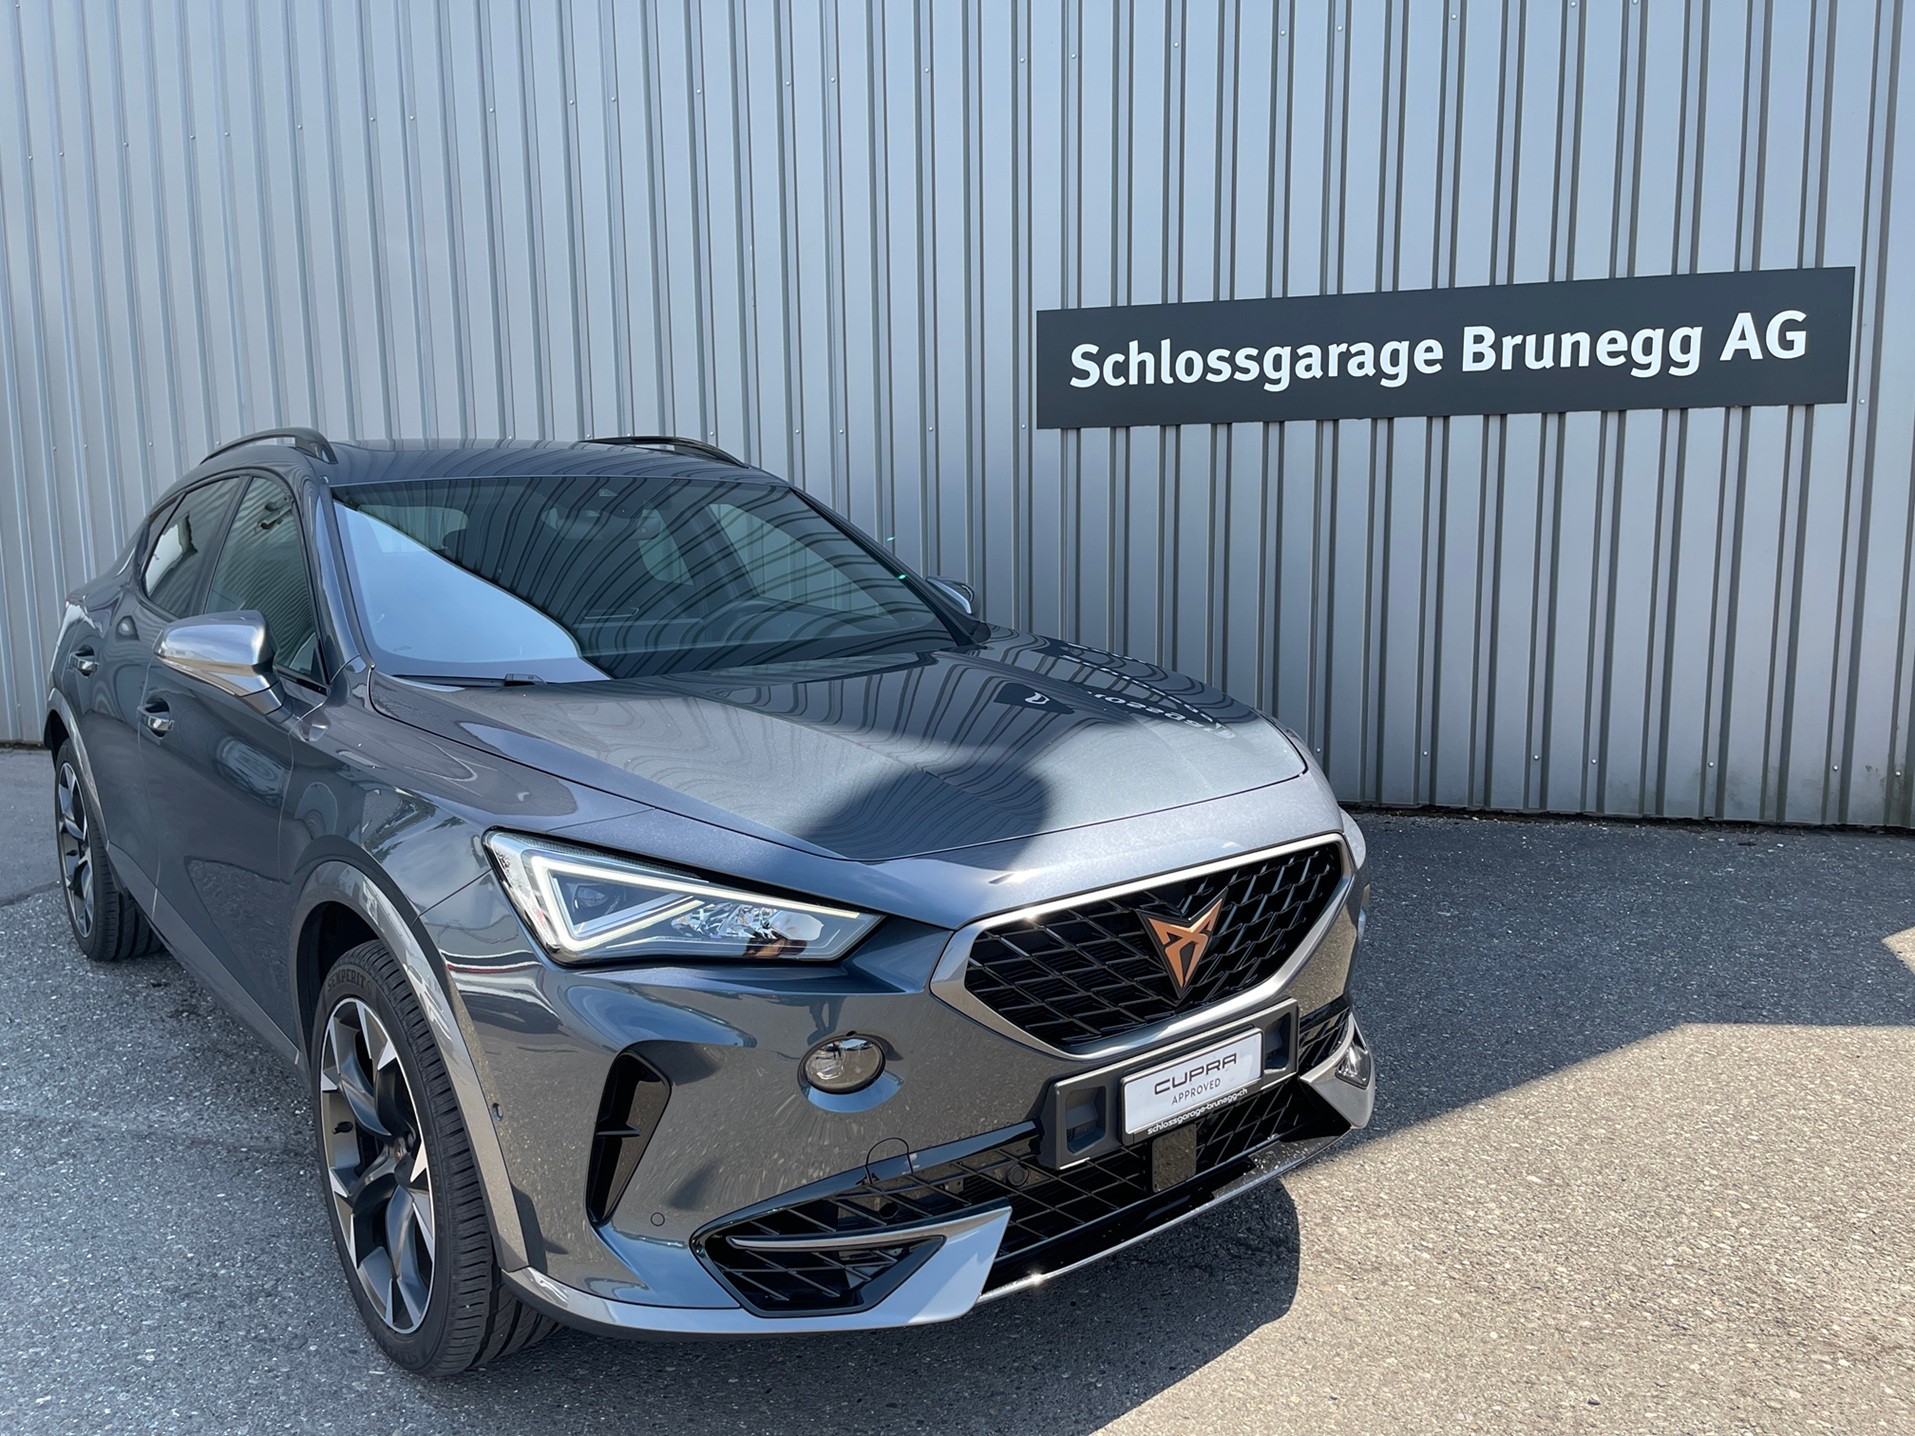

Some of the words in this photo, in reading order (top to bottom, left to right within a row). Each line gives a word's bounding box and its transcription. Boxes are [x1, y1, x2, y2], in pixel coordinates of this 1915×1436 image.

[1069, 338, 1444, 392] Schlossgarage
[1462, 325, 1703, 378] Brunegg
[1719, 310, 1807, 361] AG
[328, 969, 366, 992] SEMPERIT
[1155, 1053, 1237, 1095] CUPRA
[1172, 1078, 1221, 1105] APPROVED
